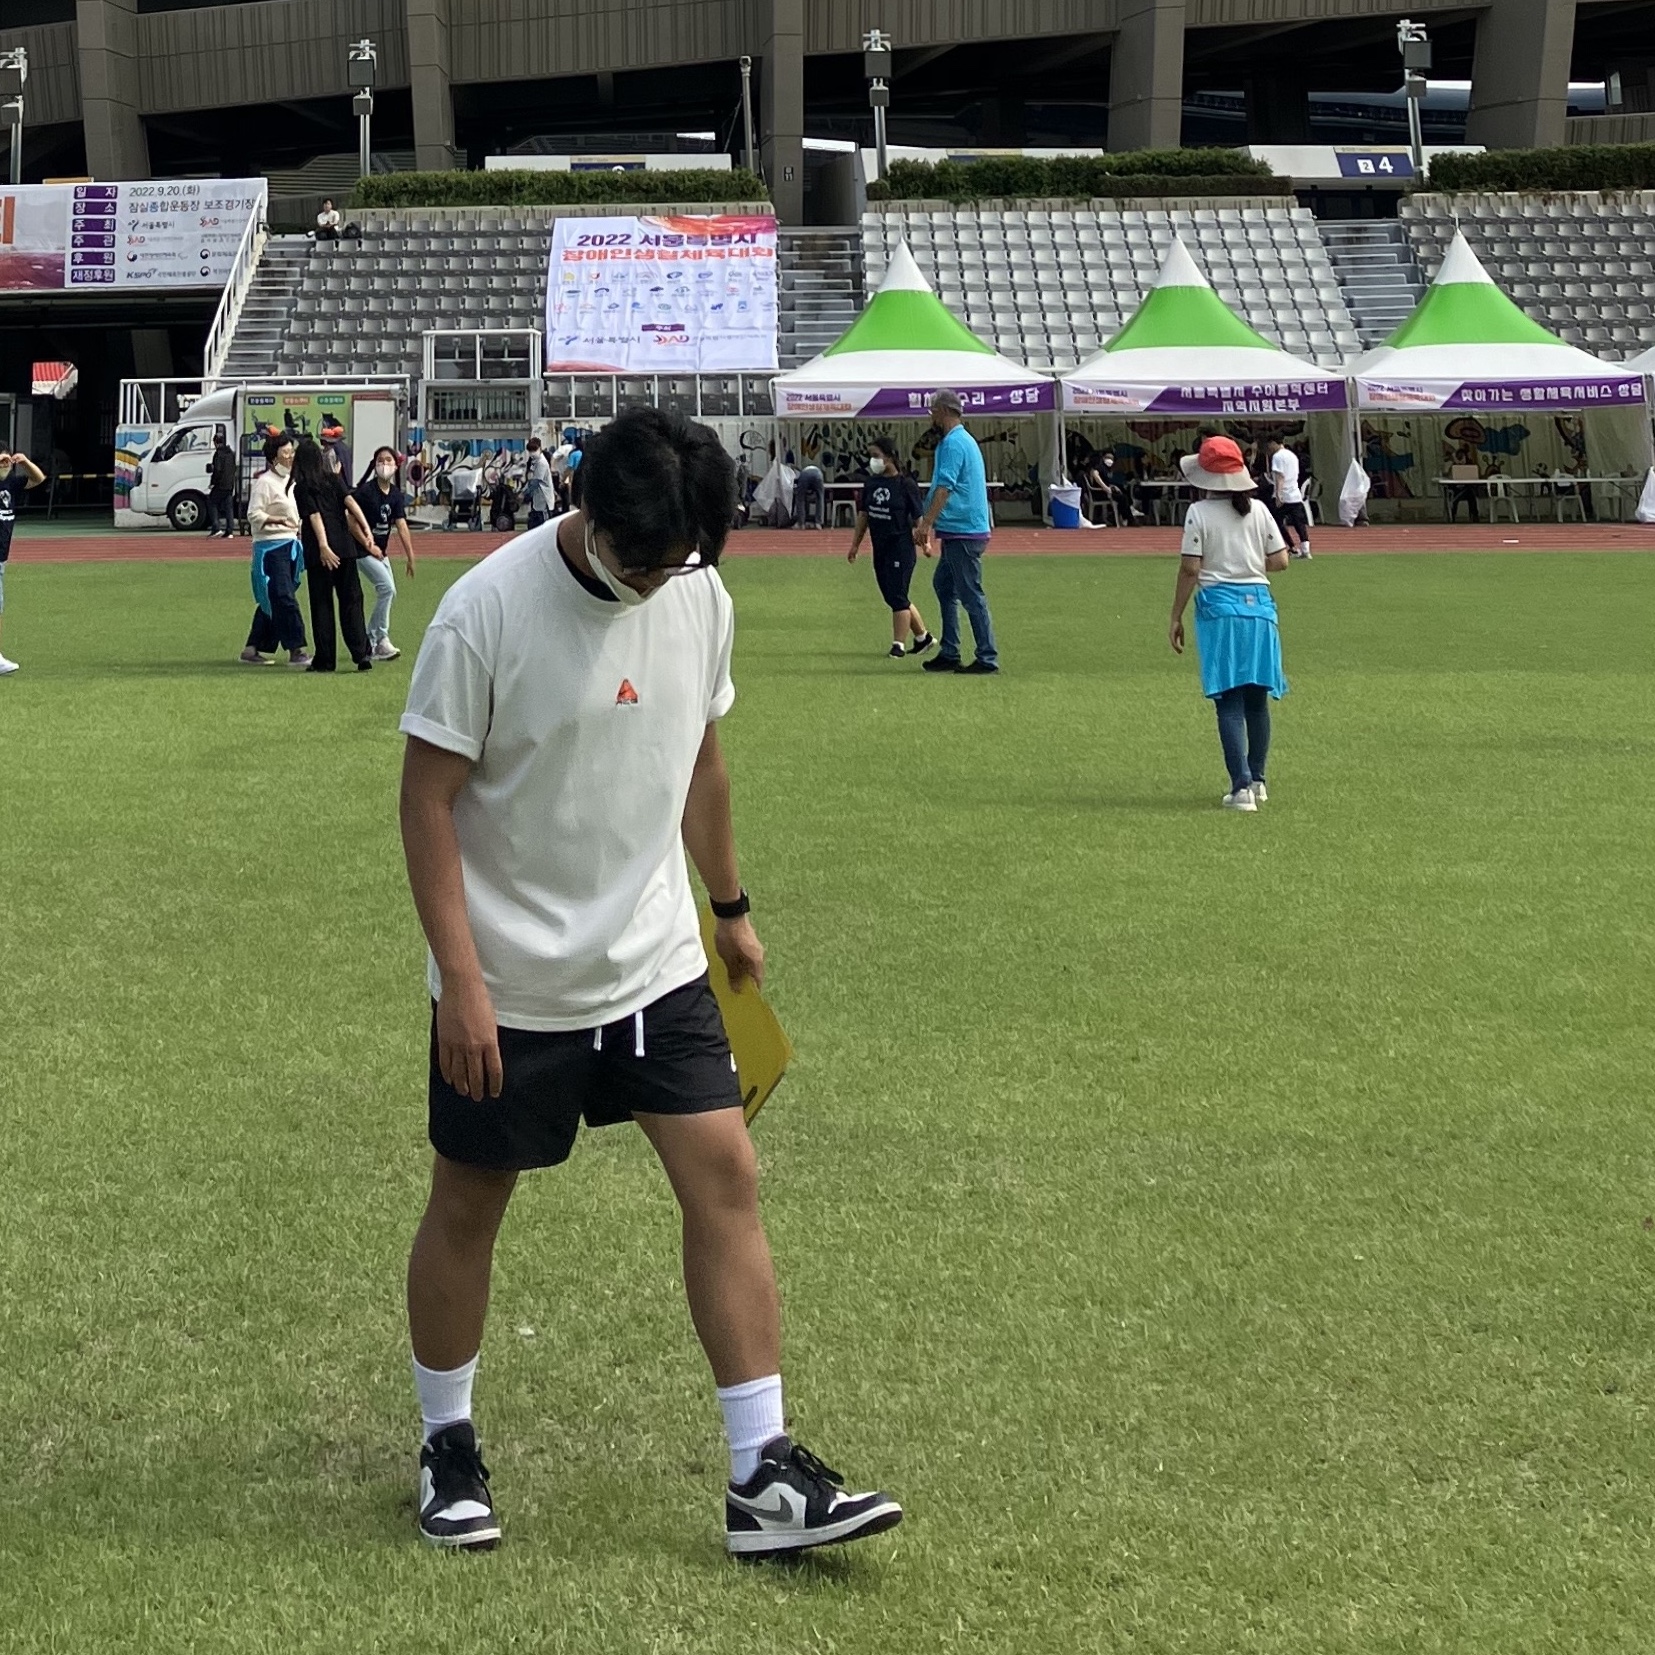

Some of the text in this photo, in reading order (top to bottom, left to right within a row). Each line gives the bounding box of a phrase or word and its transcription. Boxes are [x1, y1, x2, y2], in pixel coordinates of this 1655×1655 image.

[1378, 156, 1394, 173] 4
[128, 200, 200, 213] 잠실종합운동장
[577, 233, 632, 247] 2022
[562, 246, 773, 262] 장애인생활체육대회
[73, 270, 113, 282] 재정후원
[1009, 387, 1040, 404] 상담
[1461, 388, 1514, 402] 찾아가는
[1519, 385, 1613, 401] 생활체육서비스
